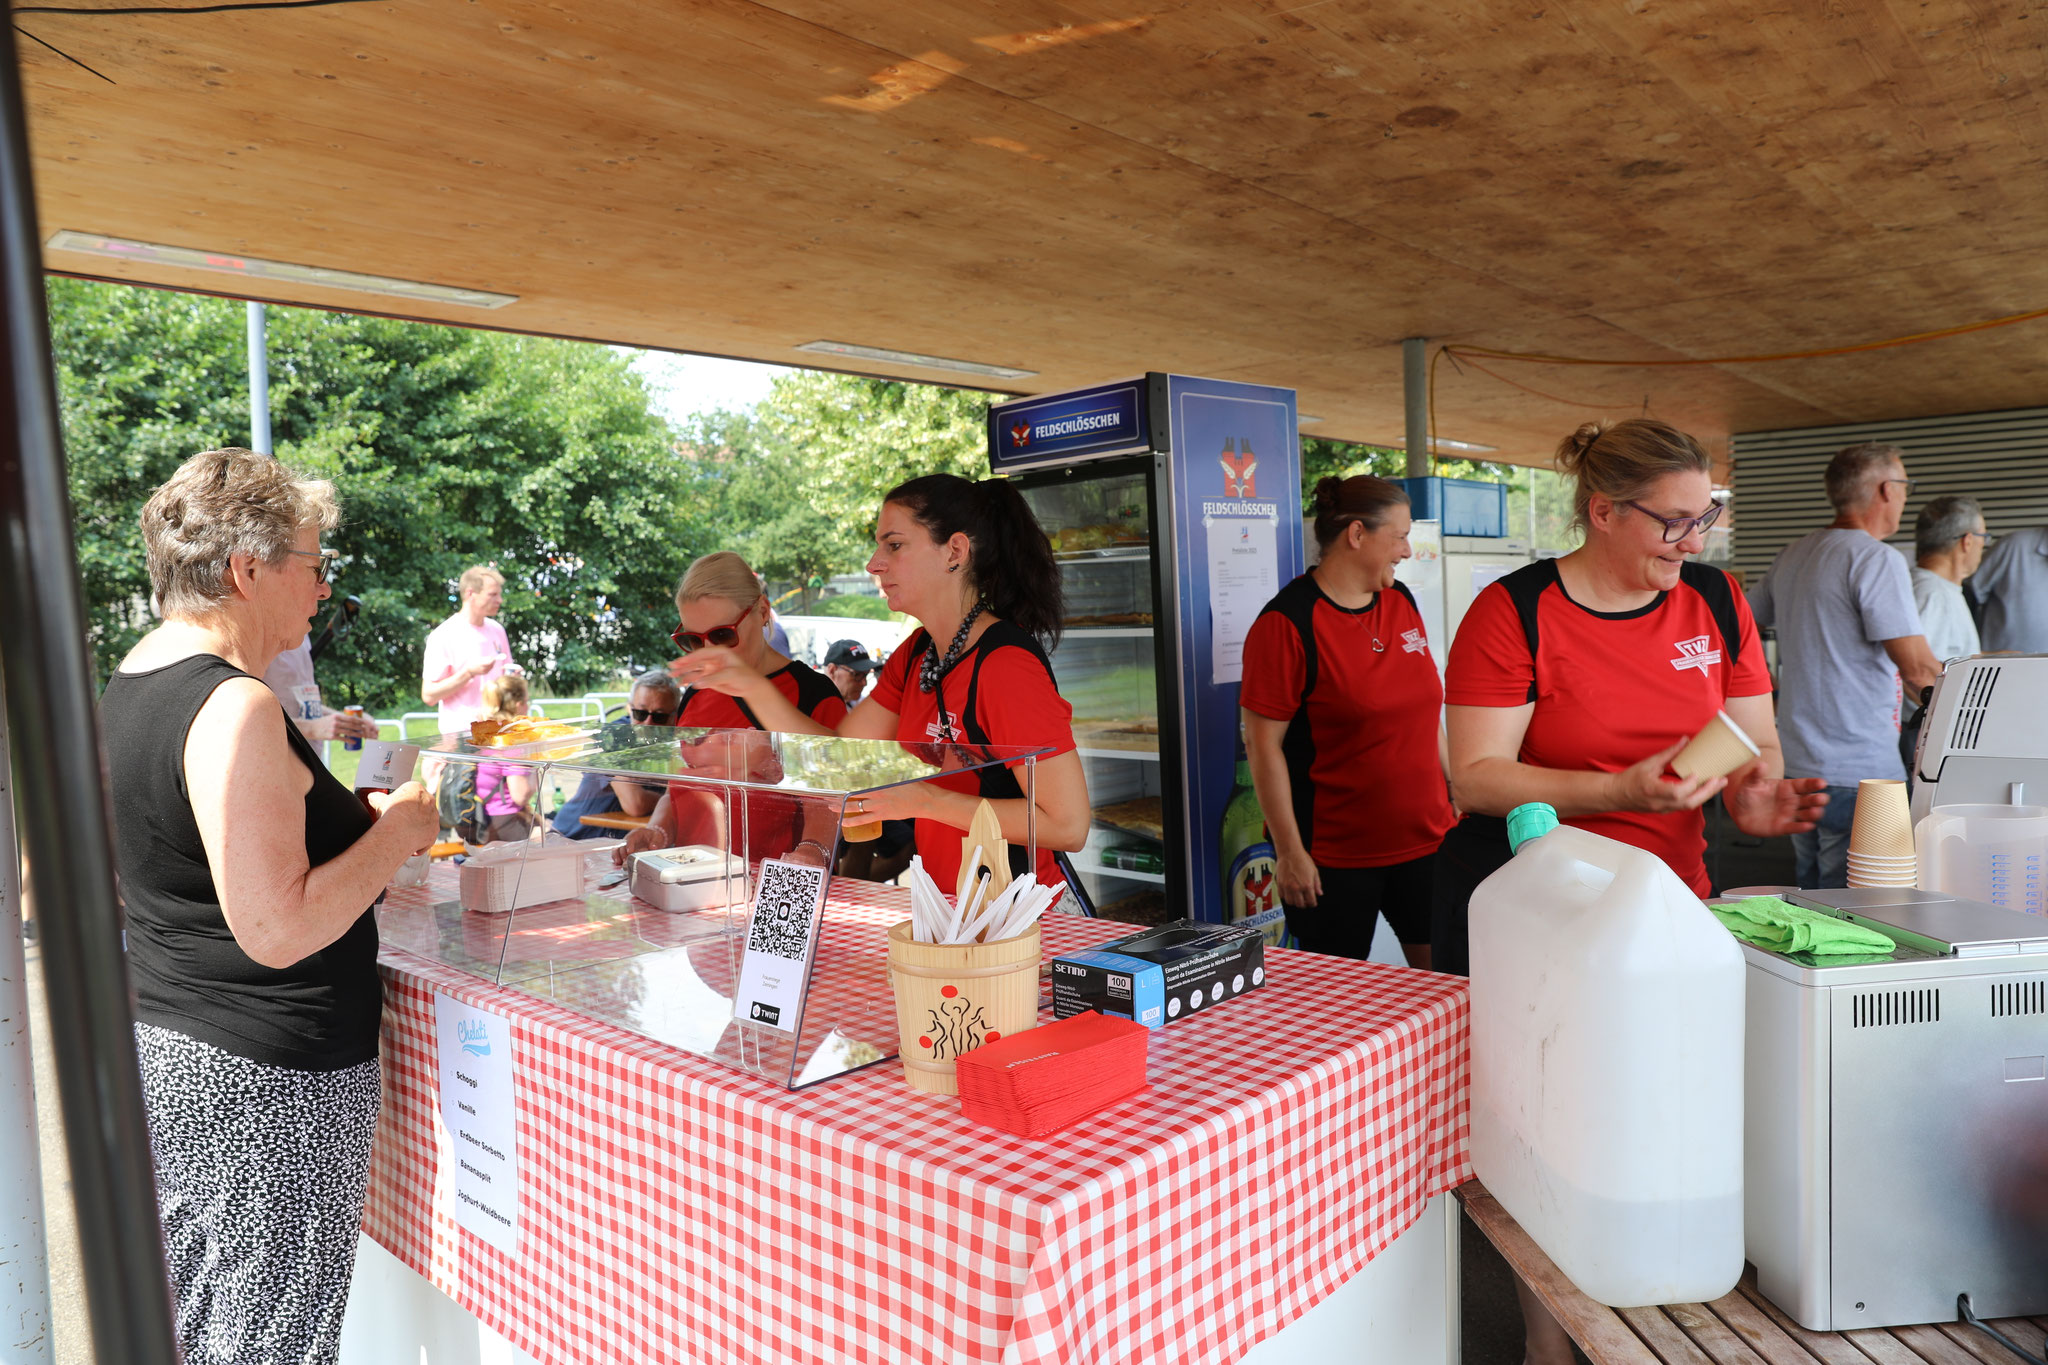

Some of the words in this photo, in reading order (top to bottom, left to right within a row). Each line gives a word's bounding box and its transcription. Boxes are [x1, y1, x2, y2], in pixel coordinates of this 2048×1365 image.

[1035, 412, 1120, 439] FELDSCHLÖSSCHEN
[1203, 500, 1277, 516] FELDSCHLÖSSCHEN
[1055, 963, 1087, 977] SETINO
[1112, 977, 1126, 988] 100
[1141, 979, 1147, 988] L
[761, 1009, 779, 1021] TWINT
[1145, 1009, 1157, 1019] 100
[457, 1018, 489, 1044] Chelati
[456, 1070, 478, 1089] Schoggi
[457, 1100, 476, 1116] Vanille
[459, 1129, 481, 1147] Erdbeer
[481, 1141, 506, 1161] Sorbetto
[460, 1159, 491, 1184] Bananasplit
[457, 1189, 512, 1228] Joghurt-Waldbeere
